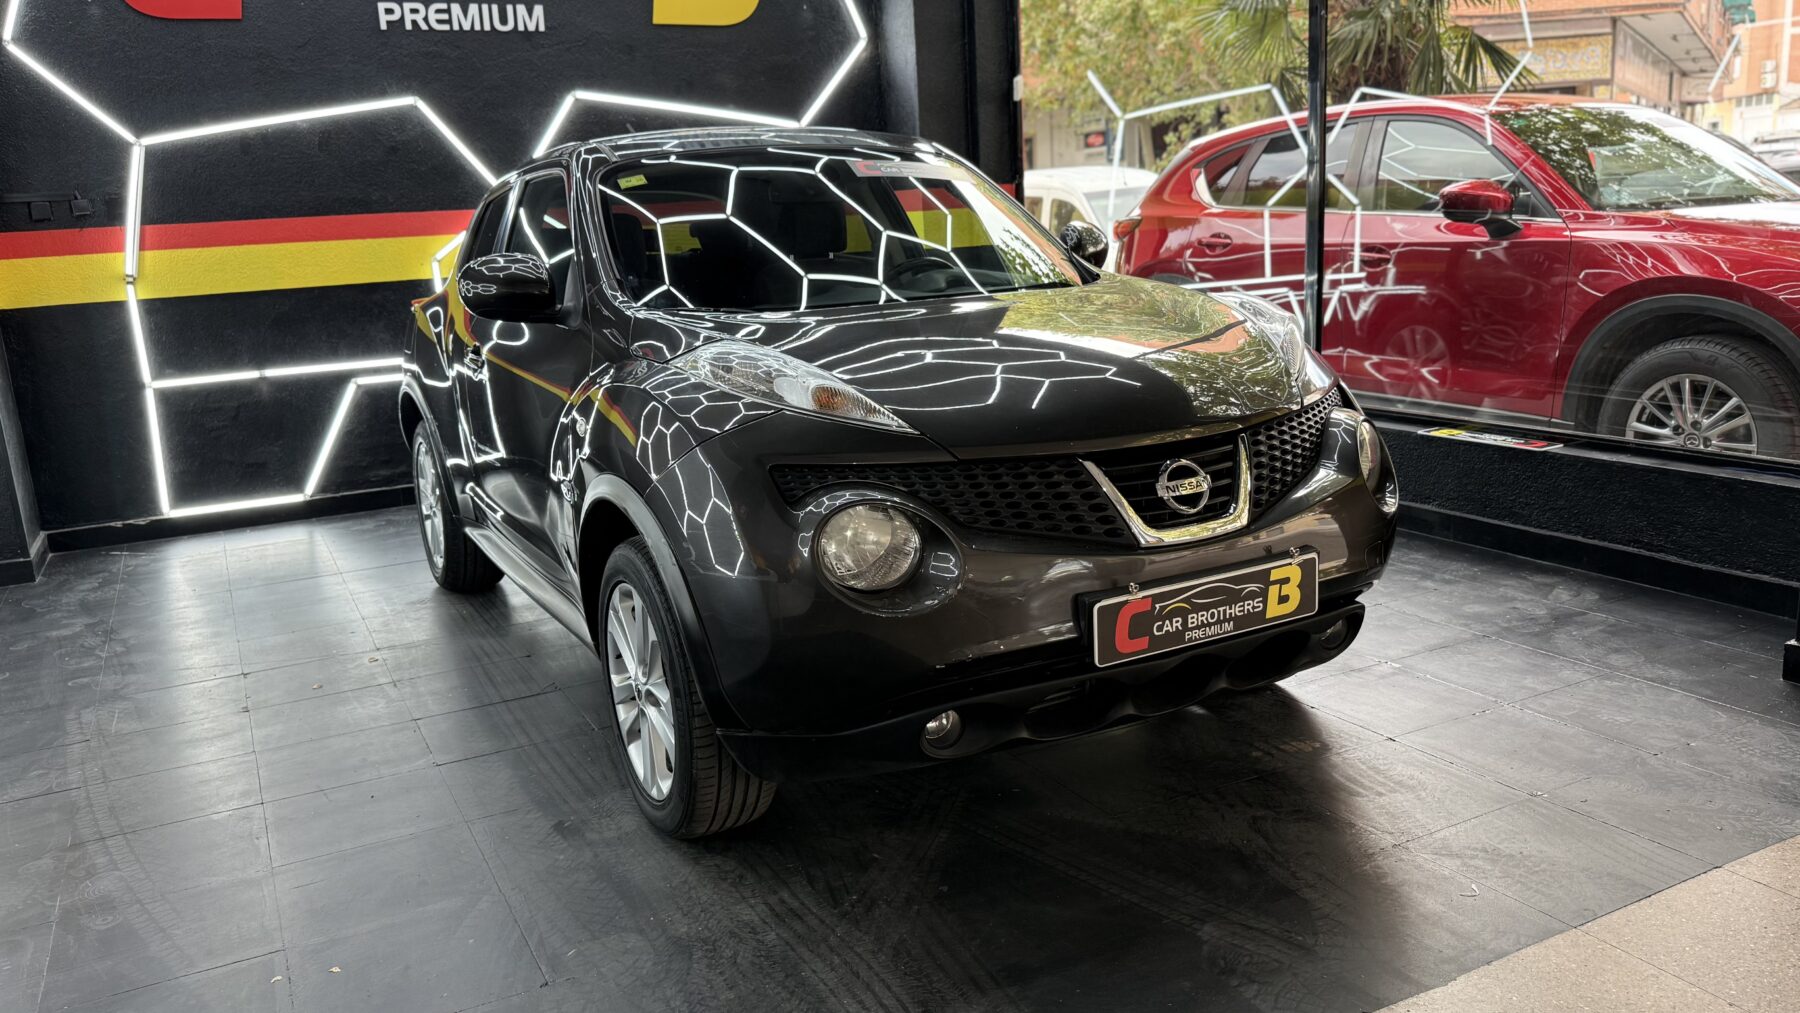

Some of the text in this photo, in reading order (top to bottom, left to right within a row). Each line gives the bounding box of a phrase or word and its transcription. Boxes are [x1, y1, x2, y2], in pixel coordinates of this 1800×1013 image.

[377, 2, 546, 32] PREMIUM
[1265, 564, 1302, 619] B
[1115, 597, 1152, 654] C
[1153, 597, 1263, 636] CAR BROTHERS
[1185, 621, 1234, 642] PREMIUM
